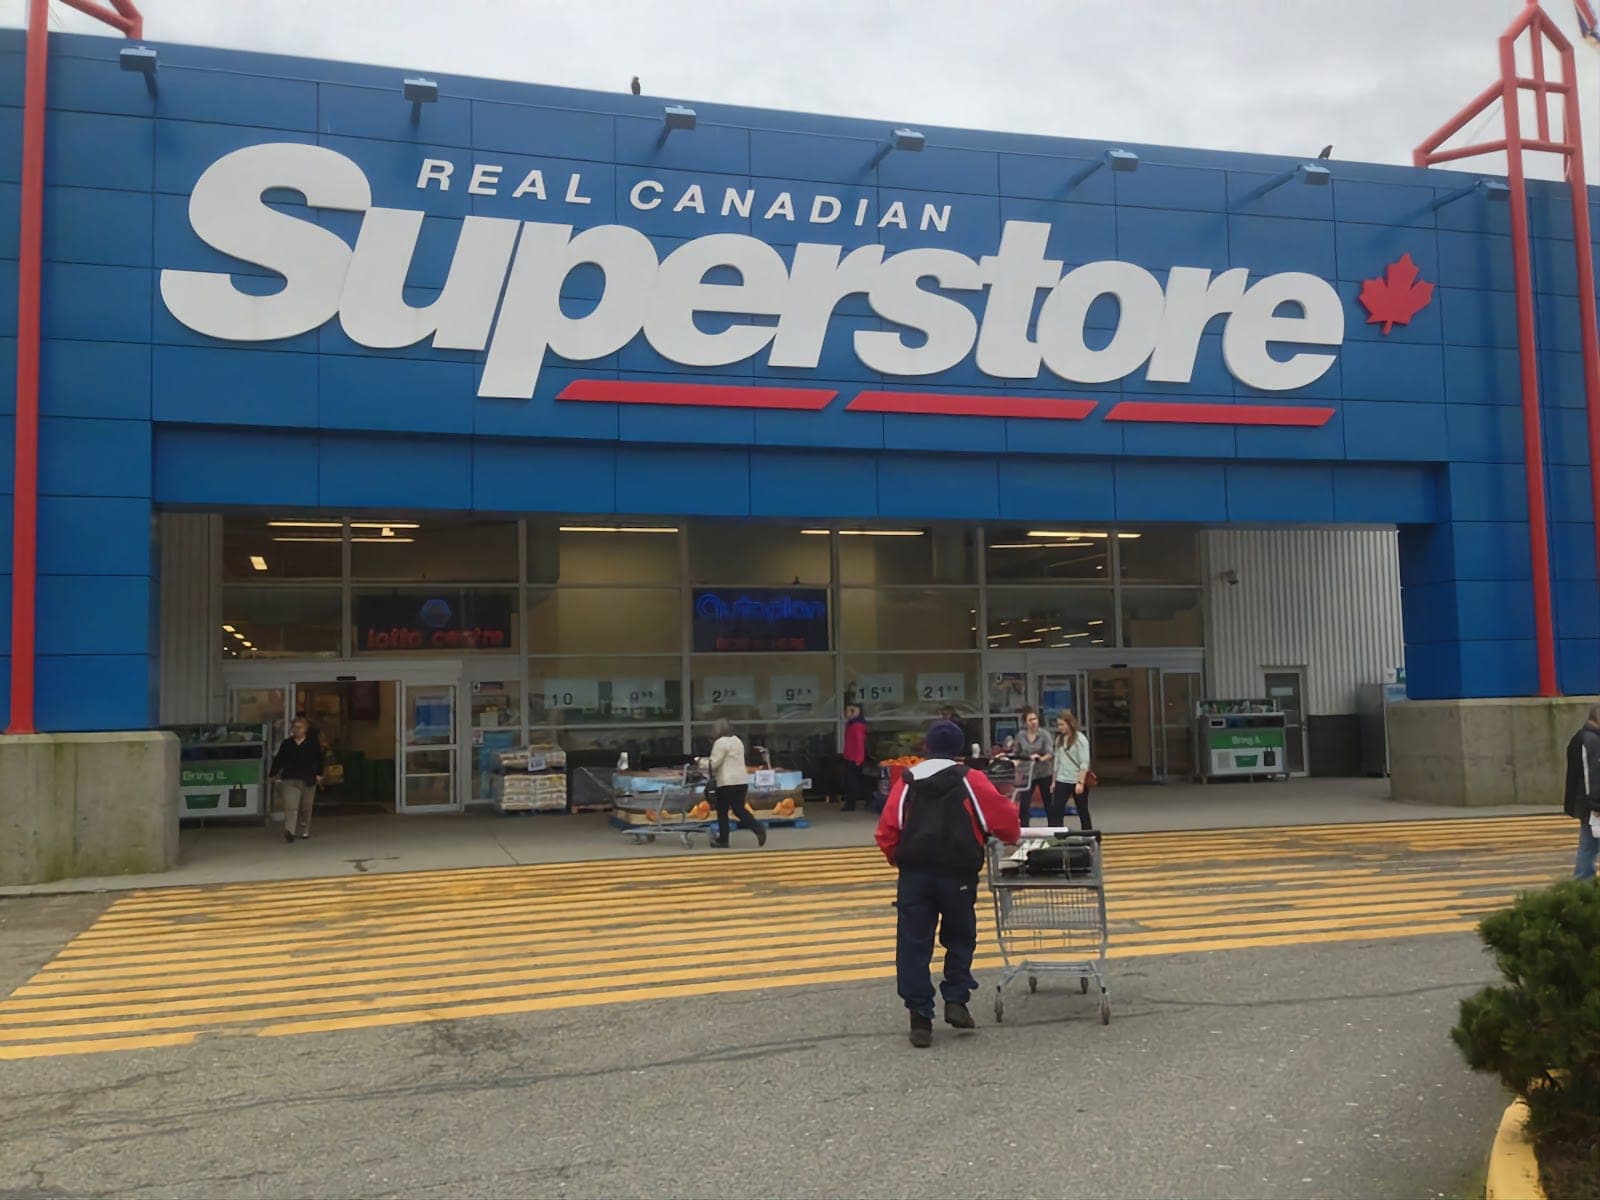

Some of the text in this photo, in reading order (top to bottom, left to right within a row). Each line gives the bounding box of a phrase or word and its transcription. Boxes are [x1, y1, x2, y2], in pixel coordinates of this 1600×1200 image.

[159, 142, 1345, 400] Superstore
[417, 158, 953, 233] REAL CANADIAN
